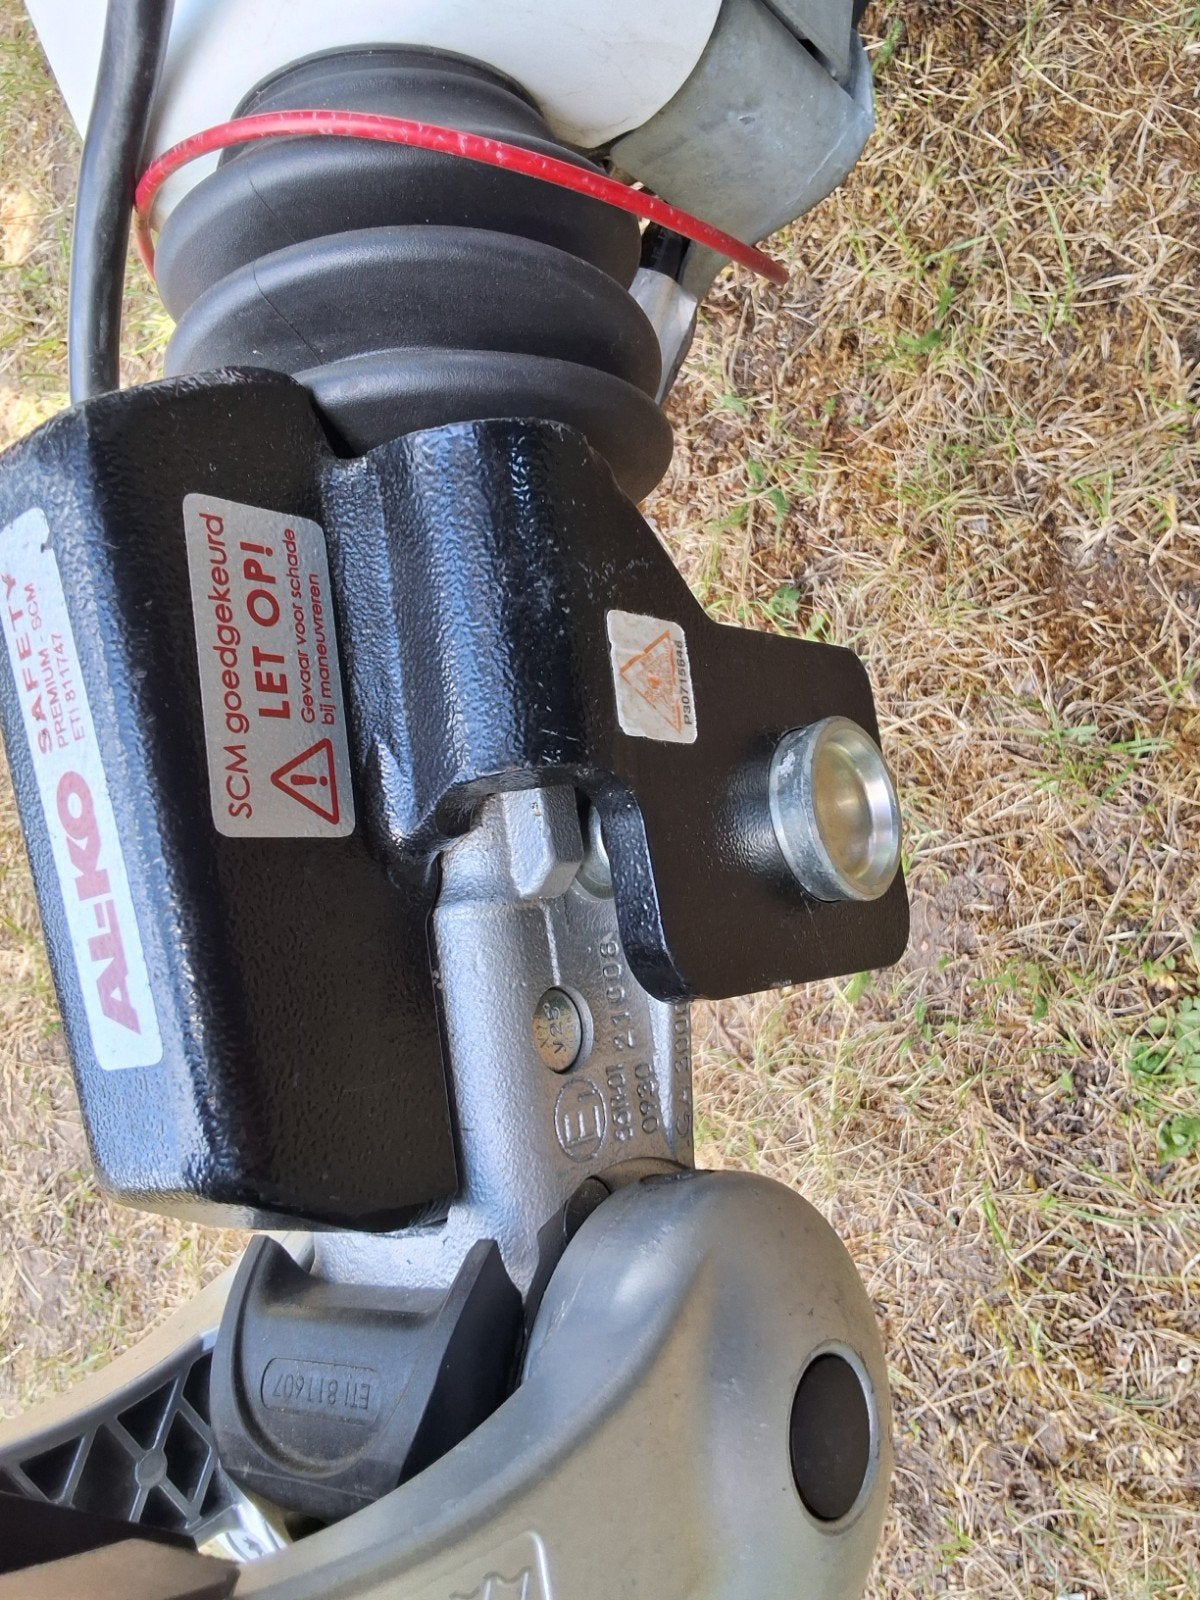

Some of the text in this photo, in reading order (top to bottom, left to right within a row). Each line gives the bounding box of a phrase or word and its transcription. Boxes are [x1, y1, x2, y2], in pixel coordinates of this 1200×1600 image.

[1, 574, 52, 754] SAFETY
[24, 583, 42, 630] SCM
[51, 633, 85, 741] ETI 811747
[199, 512, 253, 819] SCM goedgekeurd
[240, 542, 290, 719] LET OP!
[282, 529, 316, 724] Gevaar voor schade
[306, 573, 336, 725] bij maneuvreren
[38, 648, 69, 748] PREMIUM
[56, 771, 142, 1035] AL-KO
[272, 1374, 370, 1410] ETI 811607
